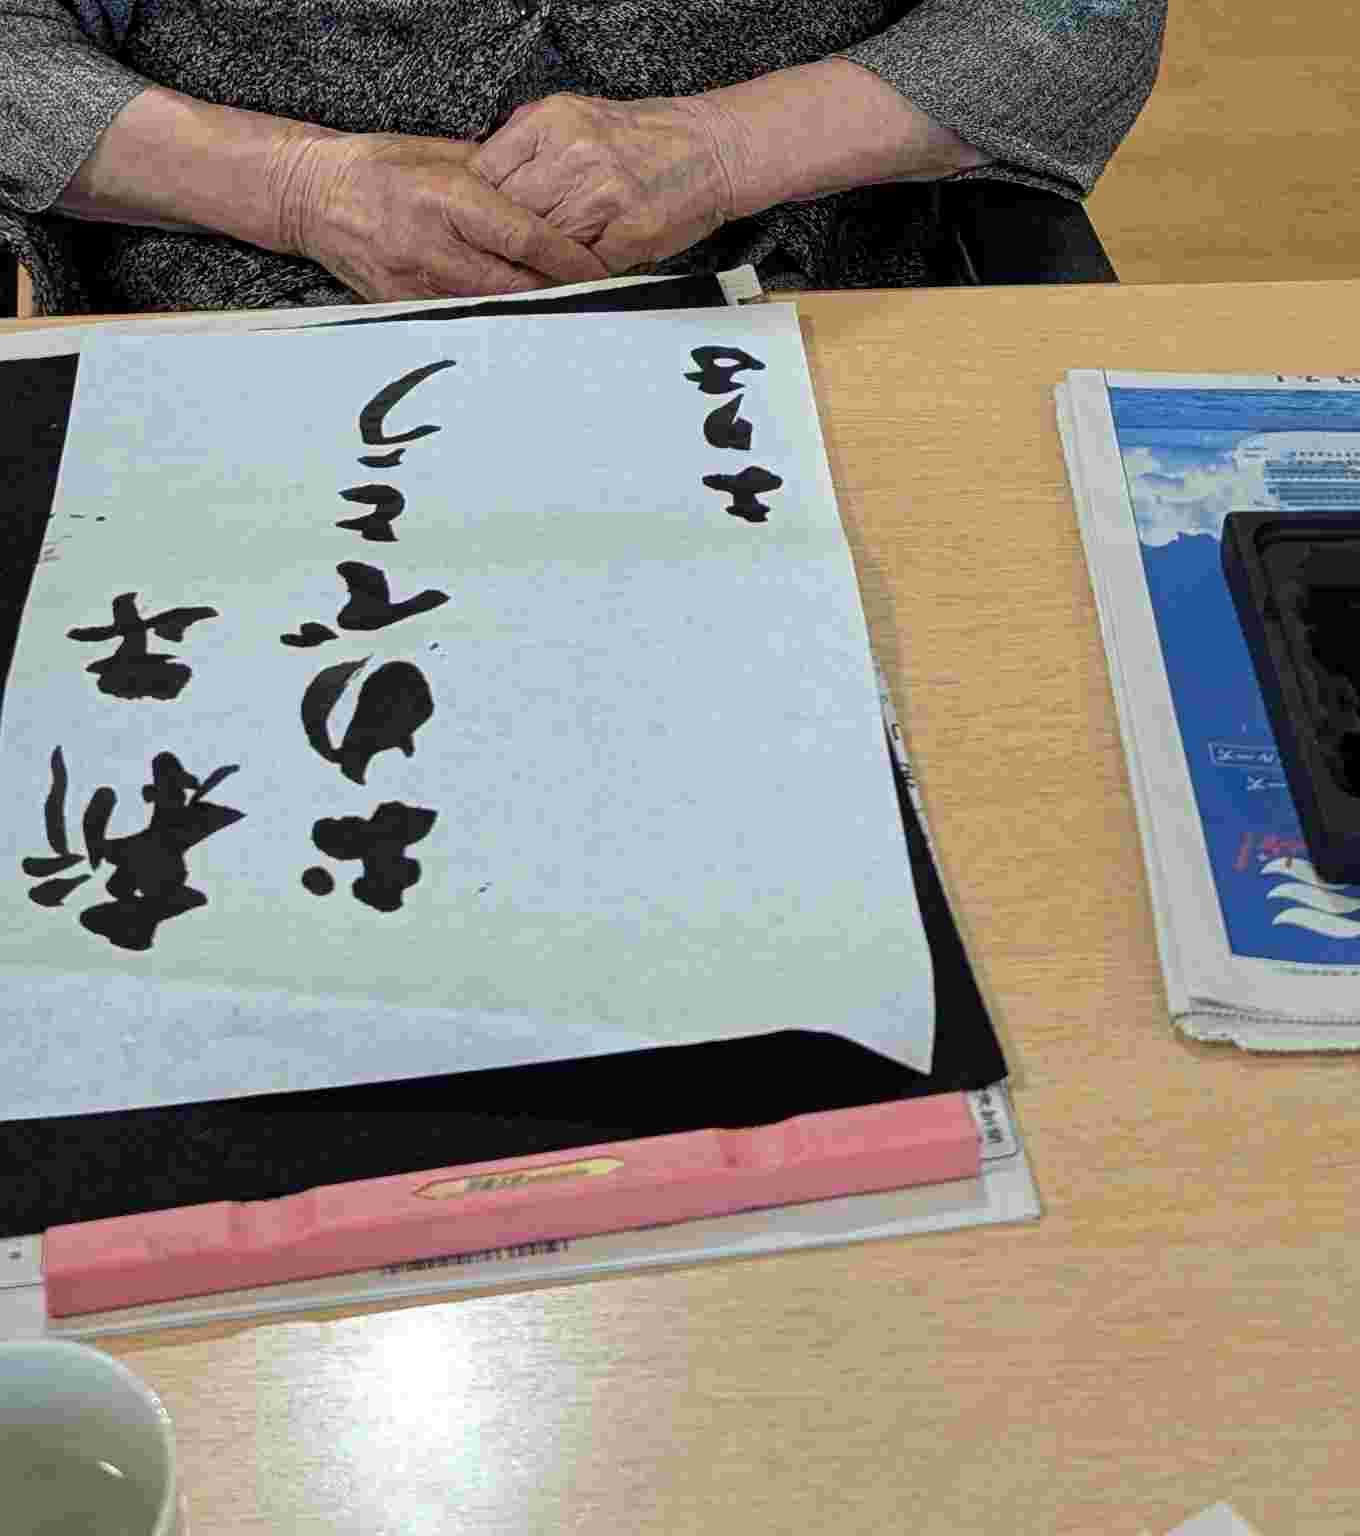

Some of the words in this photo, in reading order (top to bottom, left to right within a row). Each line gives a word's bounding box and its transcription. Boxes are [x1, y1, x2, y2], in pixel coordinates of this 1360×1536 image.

[21, 591, 247, 952] 新年
[279, 359, 457, 913] おめでとう
